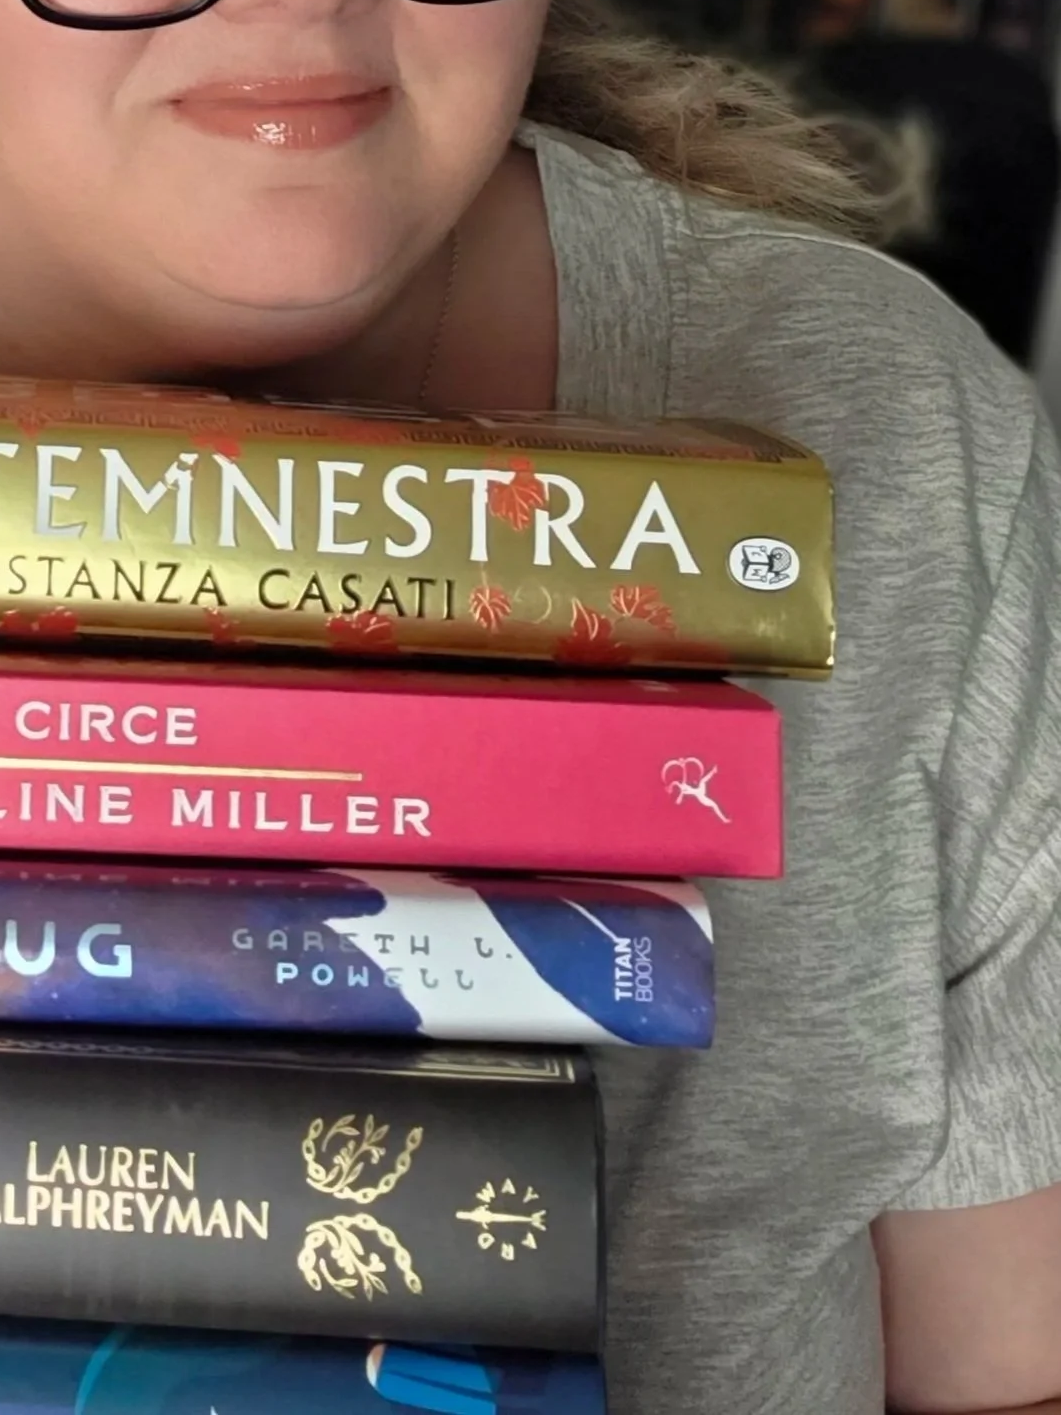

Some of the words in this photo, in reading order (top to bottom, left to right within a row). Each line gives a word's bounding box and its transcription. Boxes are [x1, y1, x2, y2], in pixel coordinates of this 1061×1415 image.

[256, 567, 456, 621] CASATI
[14, 699, 199, 746] CIRCE
[170, 787, 433, 837] MILLER
[231, 927, 432, 956] GARETH
[274, 961, 476, 991] POWELL
[615, 936, 633, 1002] TITAN
[634, 934, 654, 1003] BOOKS
[25, 1140, 198, 1192] LAUREN
